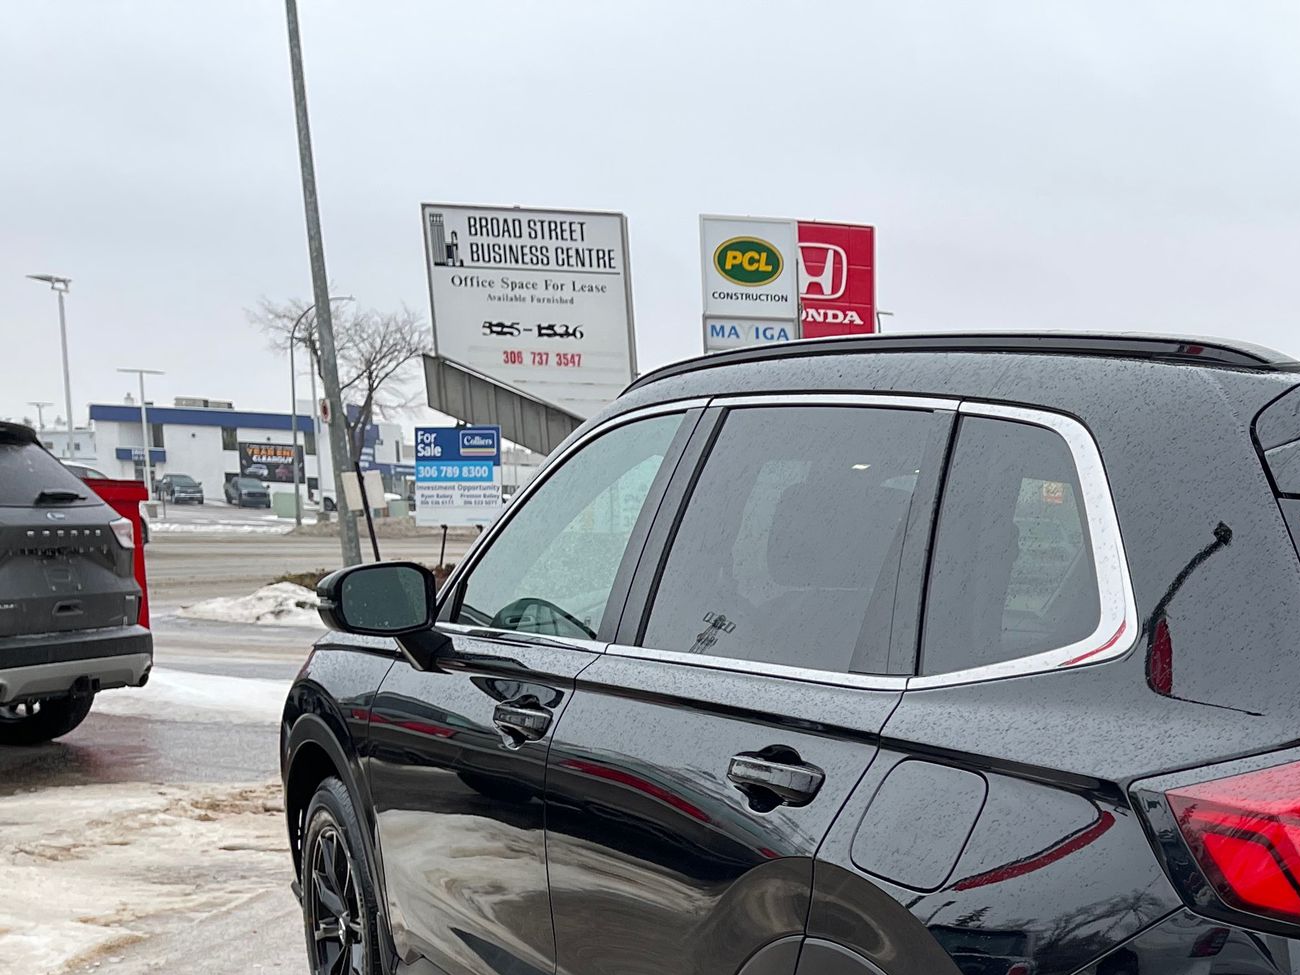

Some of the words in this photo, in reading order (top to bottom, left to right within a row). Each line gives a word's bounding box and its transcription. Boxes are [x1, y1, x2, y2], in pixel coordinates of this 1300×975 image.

[468, 216, 523, 240] BROAD
[528, 219, 586, 242] STREET
[469, 243, 551, 266] BUSINESS
[555, 246, 617, 269] CENTRE
[725, 250, 773, 272] PCL
[451, 274, 495, 289] Office
[501, 277, 538, 292] Space
[544, 279, 565, 292] For
[572, 280, 607, 294] Lease
[487, 294, 526, 304] Available
[712, 291, 788, 303] CONSTRUCTION
[801, 308, 864, 325] NDA
[503, 350, 523, 365] 306
[531, 351, 550, 366] 737
[556, 352, 582, 368] 3547
[417, 431, 437, 443] For
[417, 443, 442, 457] Sale
[418, 466, 438, 478] 306
[440, 466, 459, 478] 789
[462, 466, 488, 478] 8300
